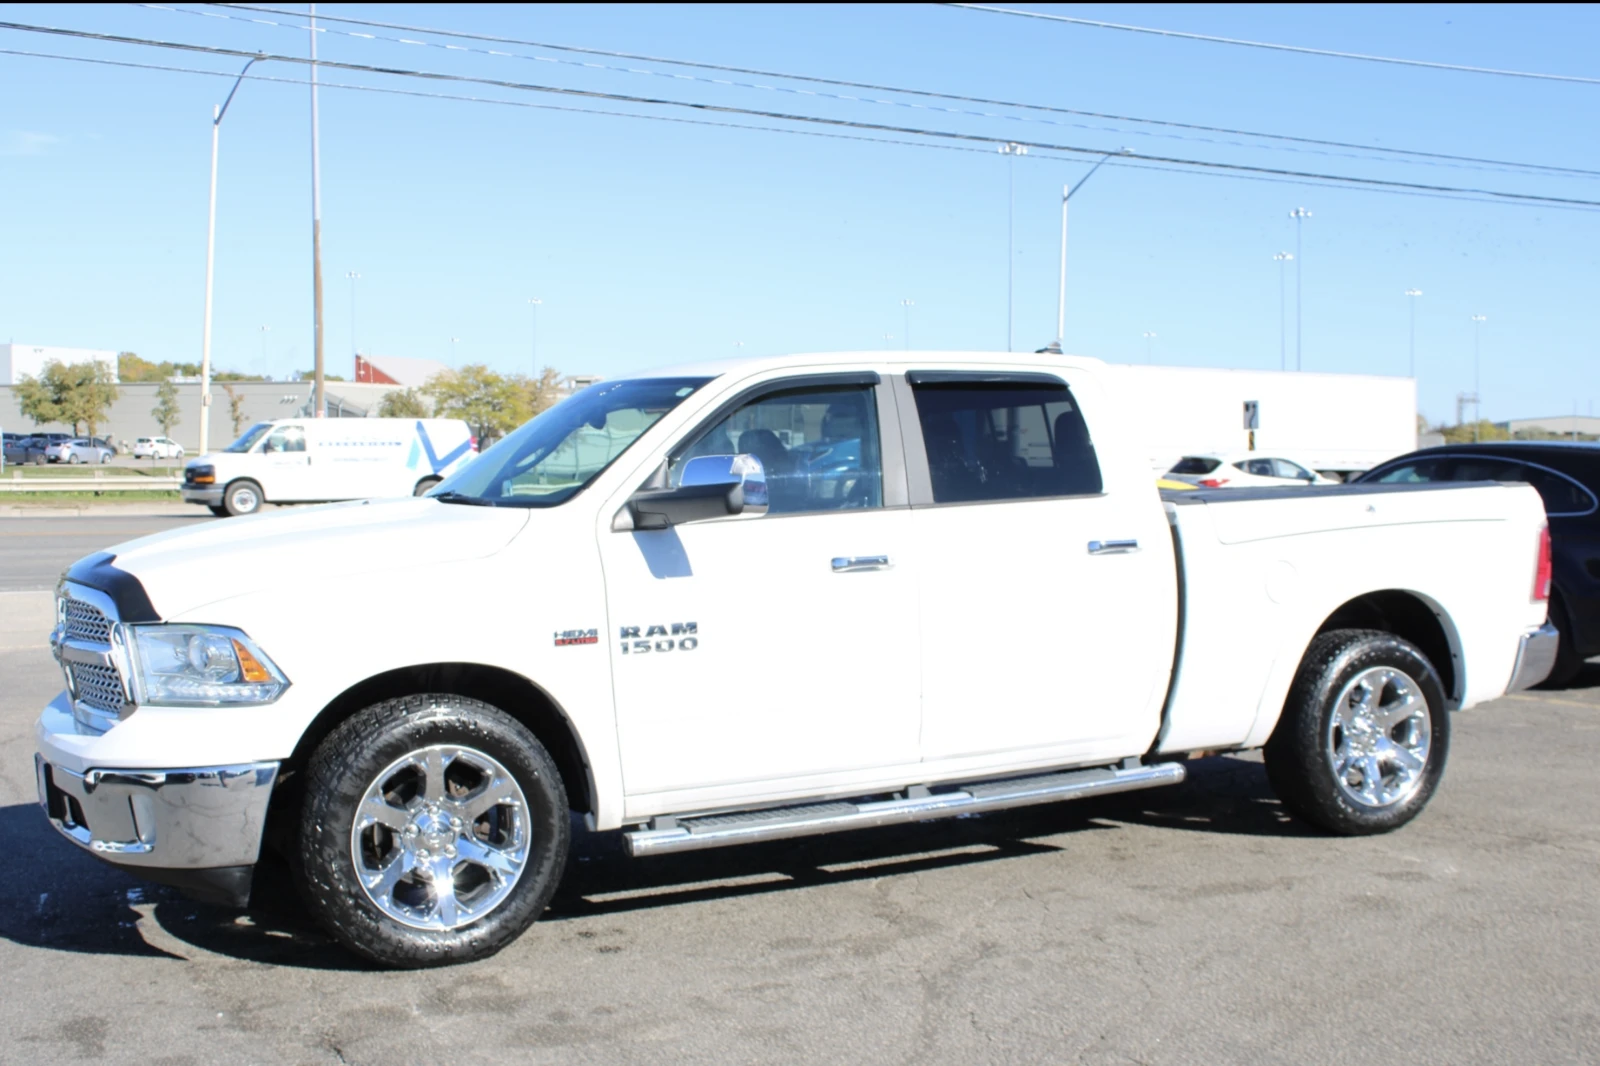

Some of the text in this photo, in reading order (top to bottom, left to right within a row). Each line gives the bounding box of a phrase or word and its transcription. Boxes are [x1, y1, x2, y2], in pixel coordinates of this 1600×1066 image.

[553, 628, 598, 639] HEMI
[620, 622, 698, 639] RAM
[620, 637, 698, 654] 1500
